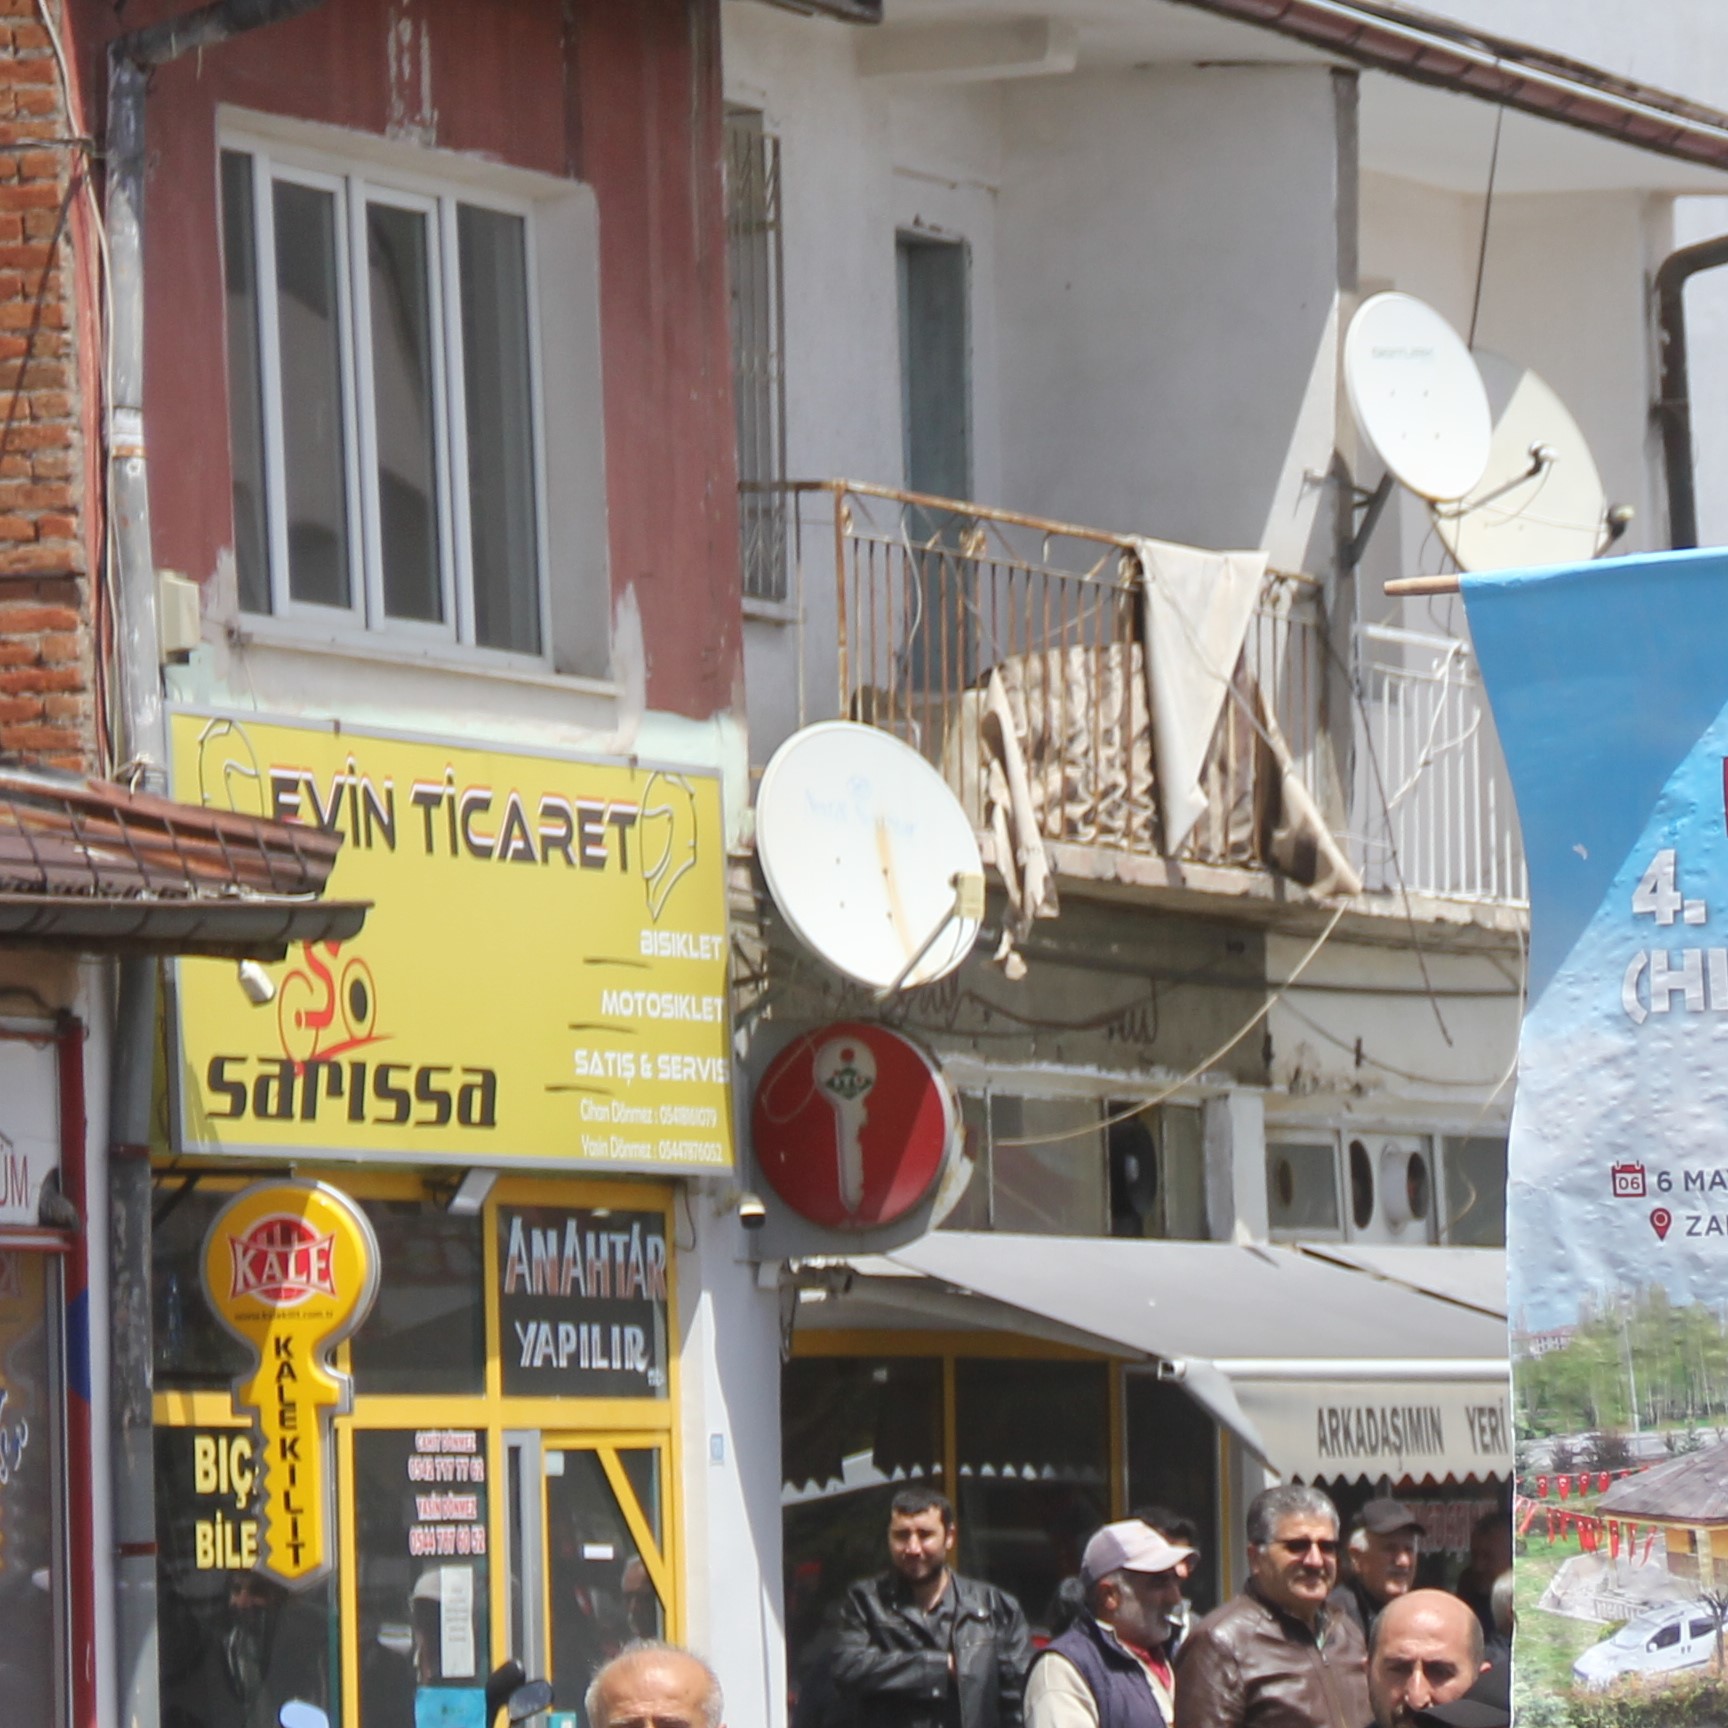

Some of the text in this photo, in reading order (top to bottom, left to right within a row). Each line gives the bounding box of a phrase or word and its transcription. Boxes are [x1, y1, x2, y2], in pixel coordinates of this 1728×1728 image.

[410, 760, 640, 872] TİCARET
[1632, 848, 1707, 925] 4.
[574, 1049, 635, 1087] SATIŞ
[1657, 1171, 1673, 1192] 6
[235, 1238, 332, 1295] KALE
[504, 1216, 668, 1300] ANAHTAR
[1464, 1398, 1510, 1455] YERİ
